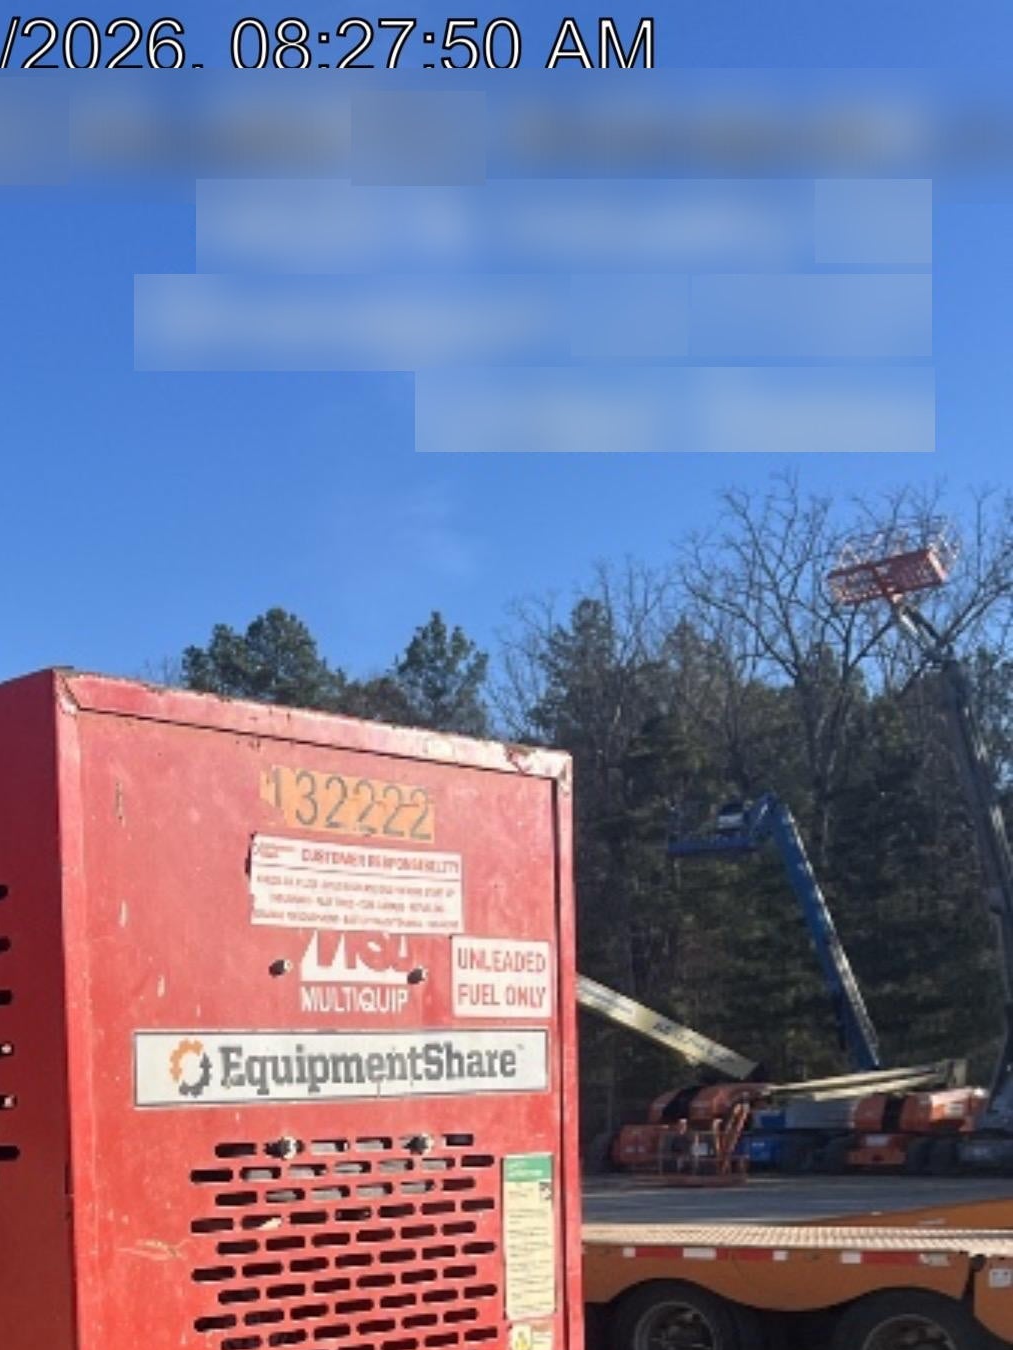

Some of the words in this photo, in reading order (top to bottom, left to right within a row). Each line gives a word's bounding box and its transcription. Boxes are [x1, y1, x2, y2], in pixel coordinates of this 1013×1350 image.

[269, 768, 432, 840] 132222
[457, 947, 547, 973] UNLEADED
[300, 986, 409, 1013] MULTIQUIP
[457, 983, 501, 1006] FUEL
[506, 984, 547, 1008] ONLY
[219, 1041, 518, 1095] EquipmentShare
